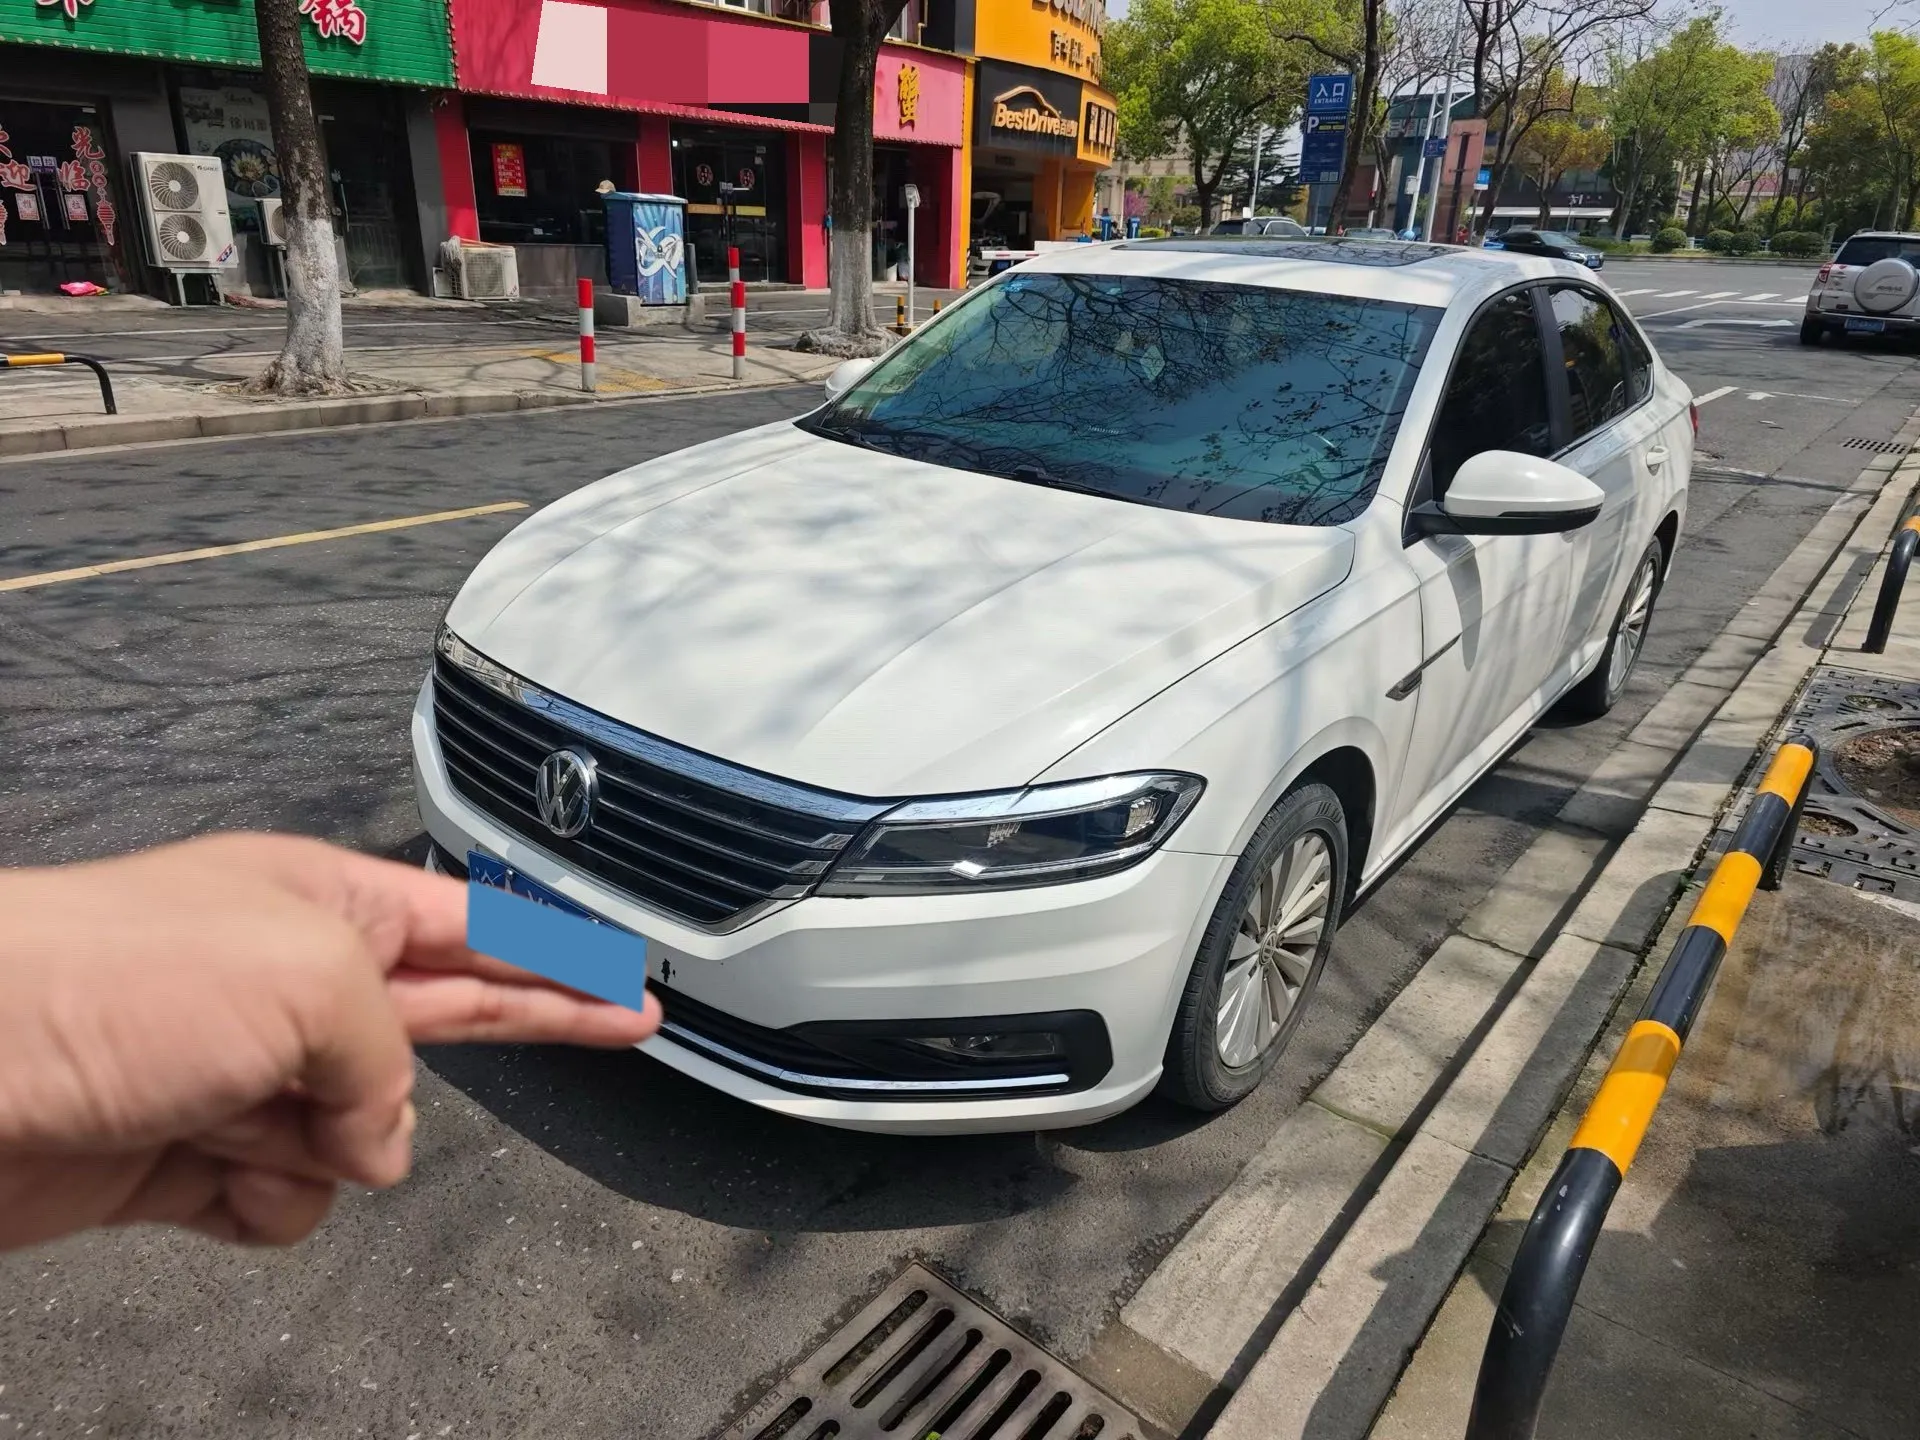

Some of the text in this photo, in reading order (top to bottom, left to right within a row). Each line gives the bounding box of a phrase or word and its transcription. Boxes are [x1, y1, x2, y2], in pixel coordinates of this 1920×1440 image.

[1316, 83, 1345, 97] 入口
[994, 103, 1060, 135] BestDrive
[1307, 116, 1319, 133] P
